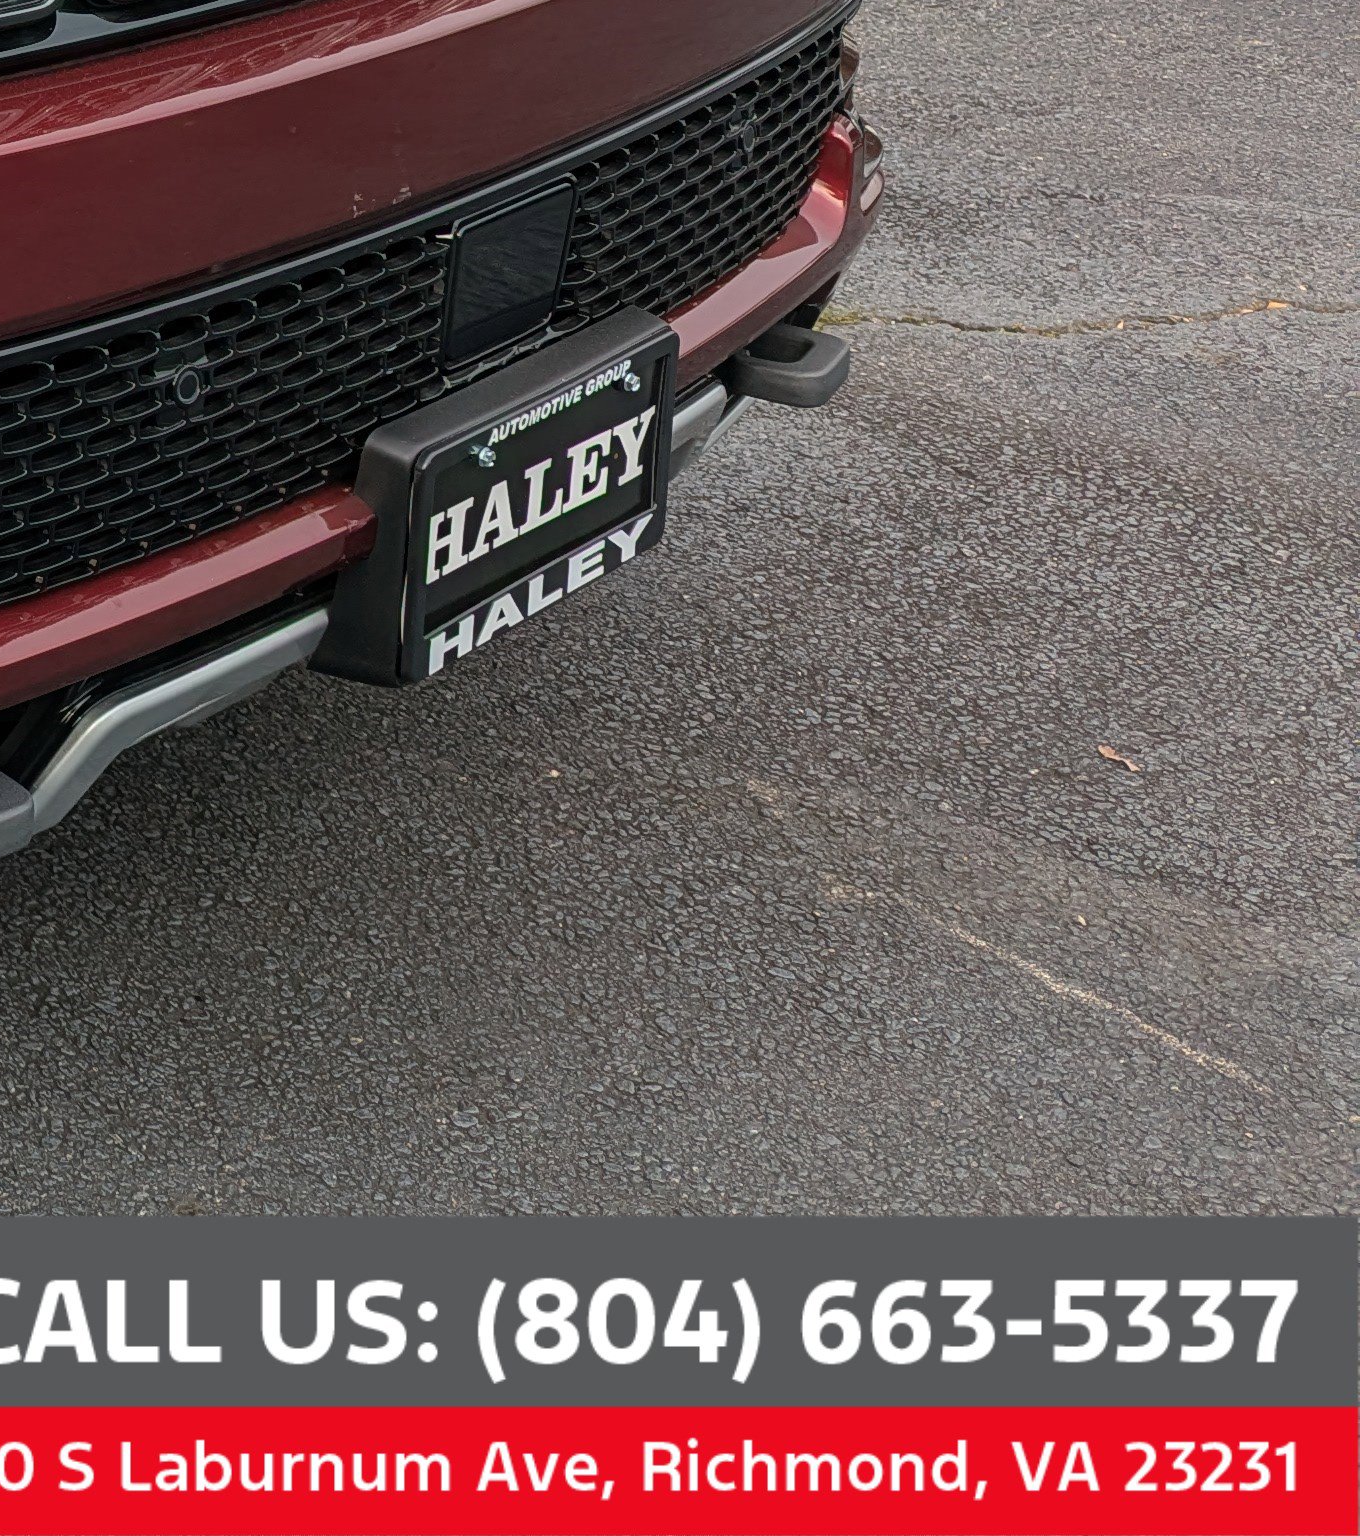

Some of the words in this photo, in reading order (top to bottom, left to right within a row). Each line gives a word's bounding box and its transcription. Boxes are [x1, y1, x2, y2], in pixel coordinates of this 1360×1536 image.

[486, 383, 583, 447] AUTOMOTIVE
[584, 359, 632, 397] GROUP
[425, 404, 657, 586] HALEY
[428, 513, 654, 677] HALEY
